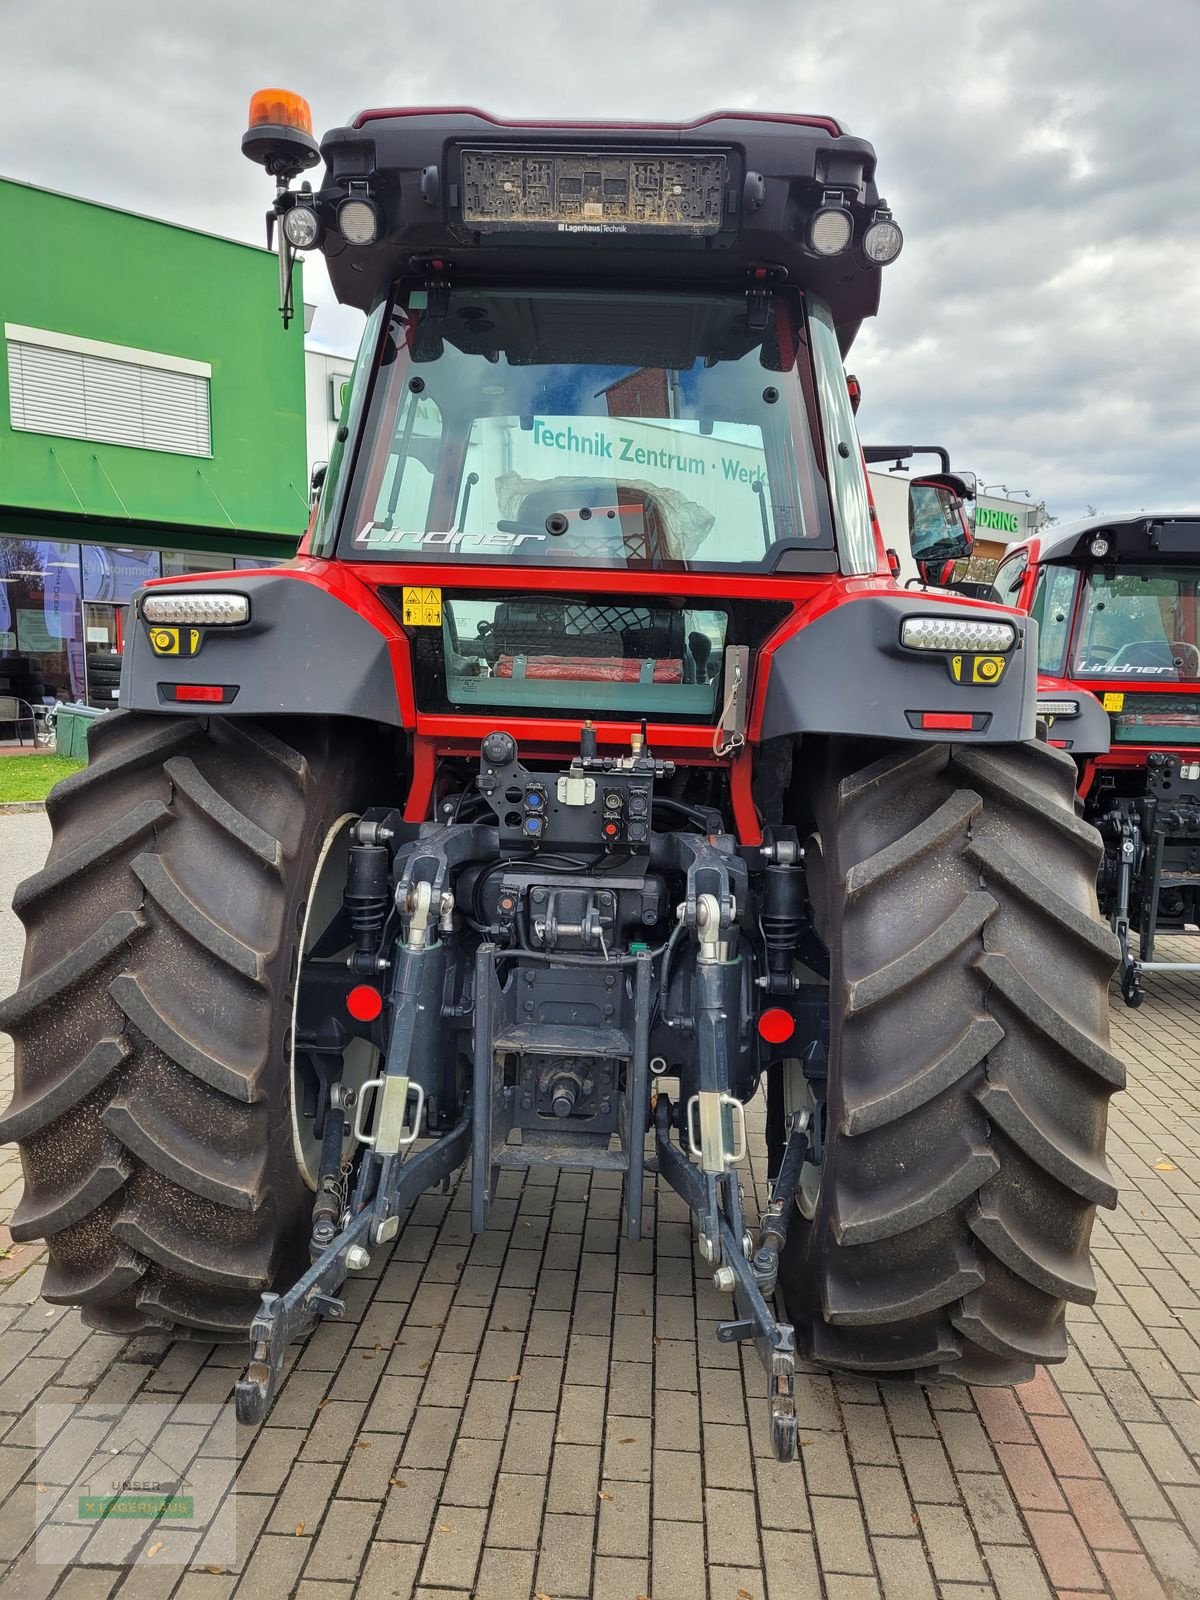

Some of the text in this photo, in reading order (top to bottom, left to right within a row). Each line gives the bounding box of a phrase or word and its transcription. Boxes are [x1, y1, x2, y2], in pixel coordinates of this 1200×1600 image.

[533, 420, 769, 486] Technik Zentrum Werk
[355, 522, 547, 547] Lindner
[1077, 661, 1174, 674] Lindner
